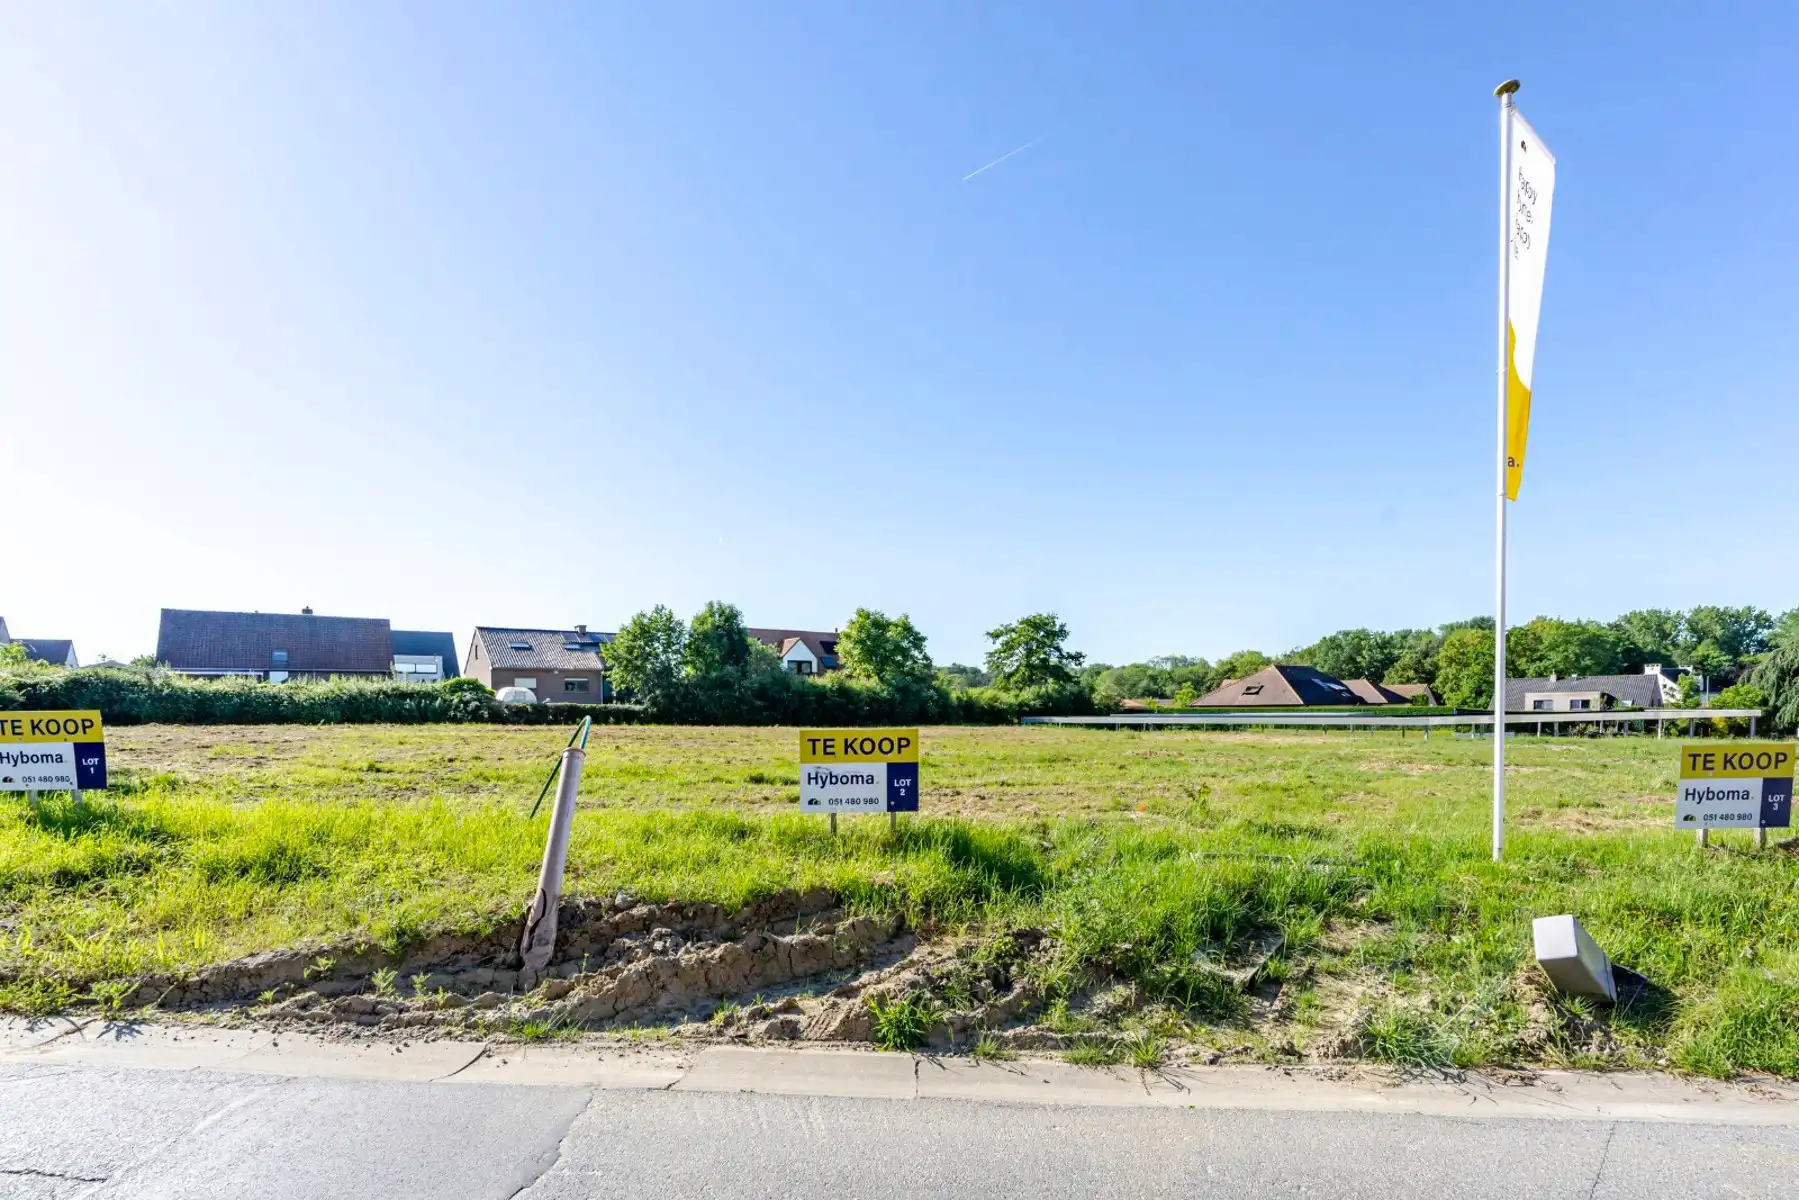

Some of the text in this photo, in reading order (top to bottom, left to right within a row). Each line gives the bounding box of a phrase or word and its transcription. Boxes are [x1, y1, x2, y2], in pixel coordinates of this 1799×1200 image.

[0, 718, 94, 736] TE KOOP
[807, 737, 911, 756] TE KOOP
[82, 758, 99, 766] LOT
[1688, 752, 1788, 771] TE KOOP
[55, 775, 71, 783] 980
[894, 779, 912, 787] LOT
[900, 788, 906, 796] 2
[828, 798, 843, 806] 051
[863, 797, 879, 805] 980
[1768, 794, 1785, 802] LOT
[1773, 803, 1779, 811] 3
[1703, 813, 1753, 821] 051 480 980
